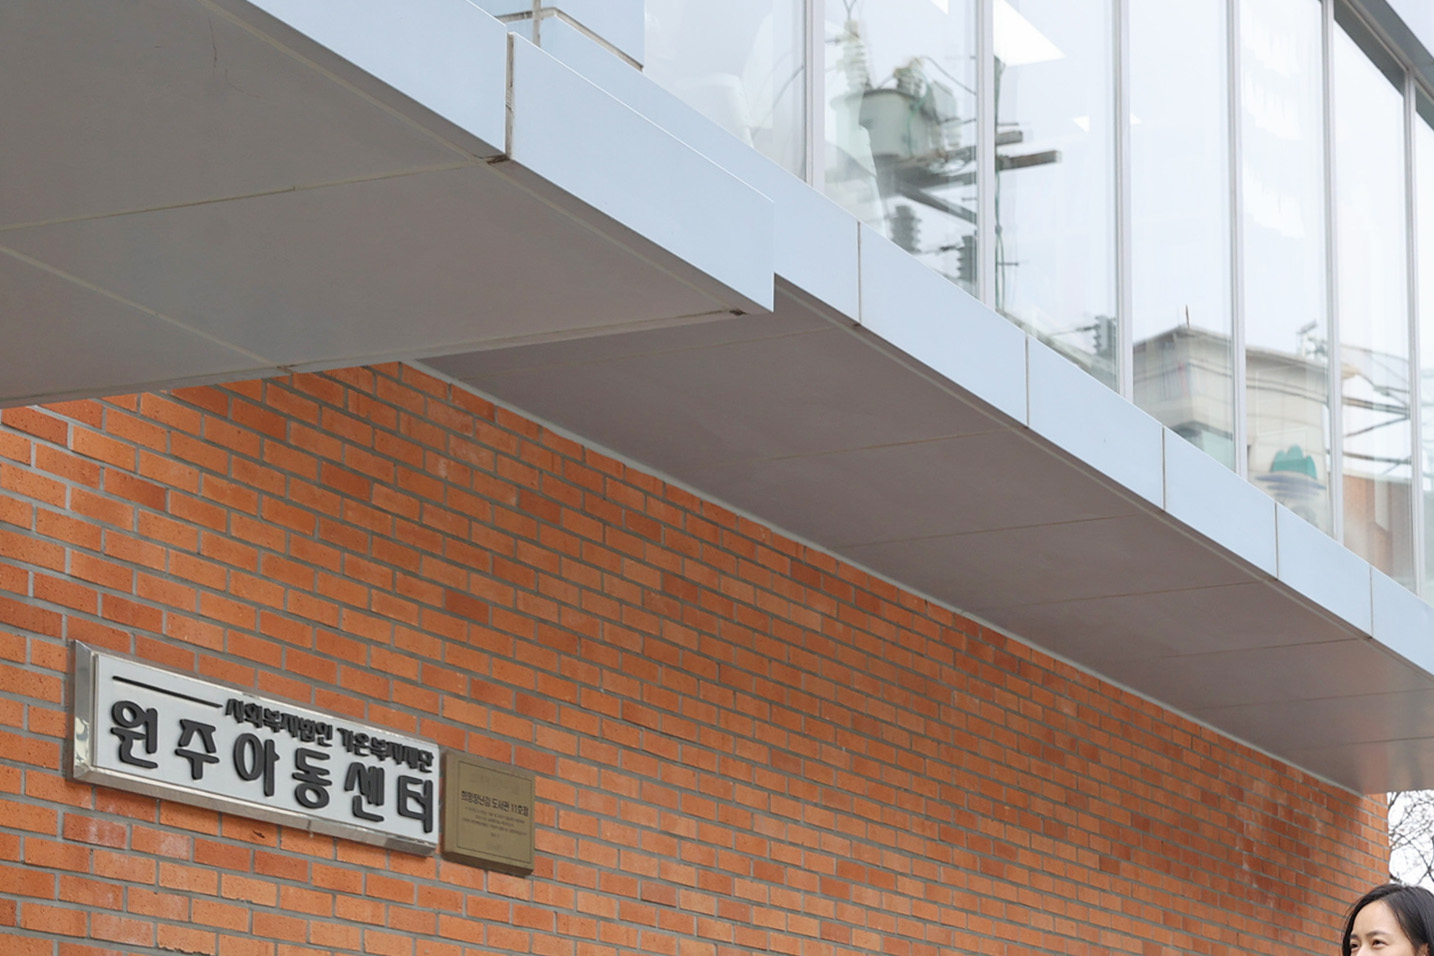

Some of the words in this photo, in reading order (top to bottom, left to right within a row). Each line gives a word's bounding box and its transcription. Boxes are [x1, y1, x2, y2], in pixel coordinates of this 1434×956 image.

[111, 699, 433, 833] 원주아동센터
[225, 698, 333, 747] 사회복지법인
[337, 727, 434, 773] 가온복지재단
